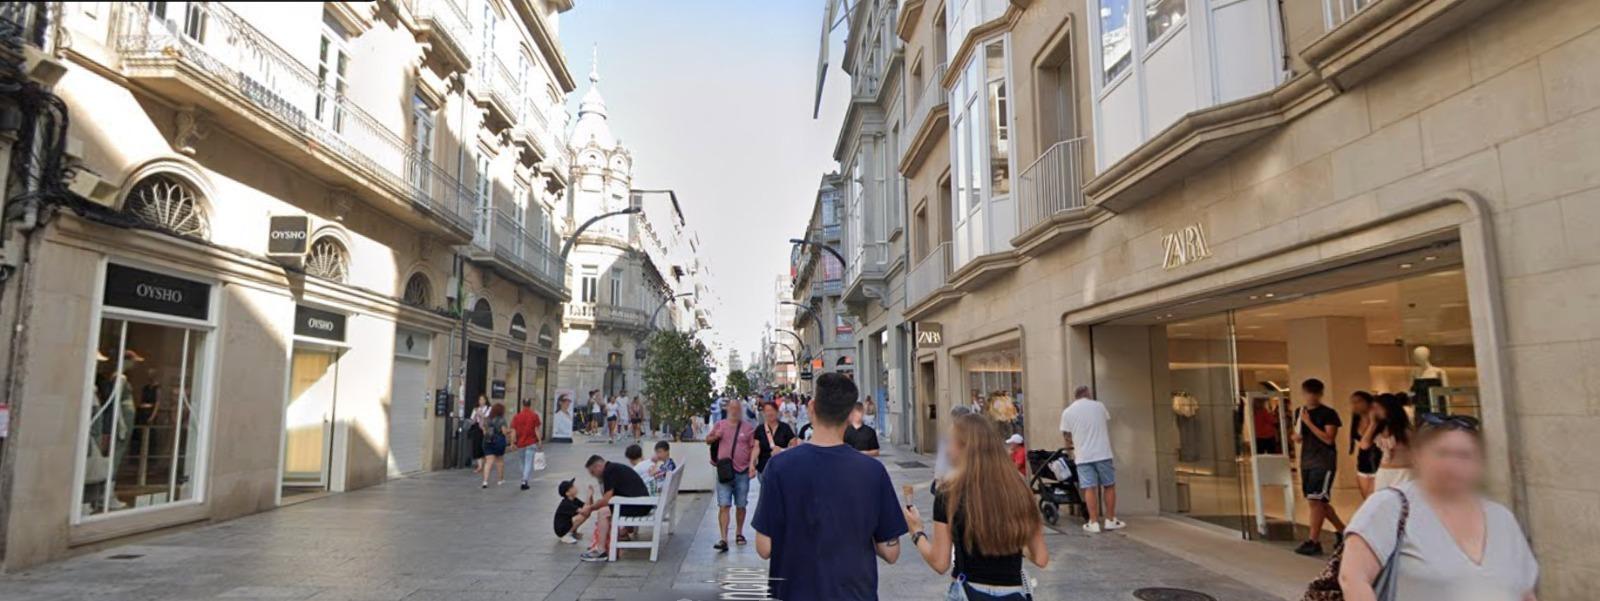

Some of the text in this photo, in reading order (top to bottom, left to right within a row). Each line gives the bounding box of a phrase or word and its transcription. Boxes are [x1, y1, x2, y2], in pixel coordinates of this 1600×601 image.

[271, 230, 306, 240] OYSHO
[1161, 223, 1212, 269] ZARA
[136, 283, 182, 303] OYSHO
[308, 318, 334, 331] OYSHO
[918, 331, 941, 344] ZARA
